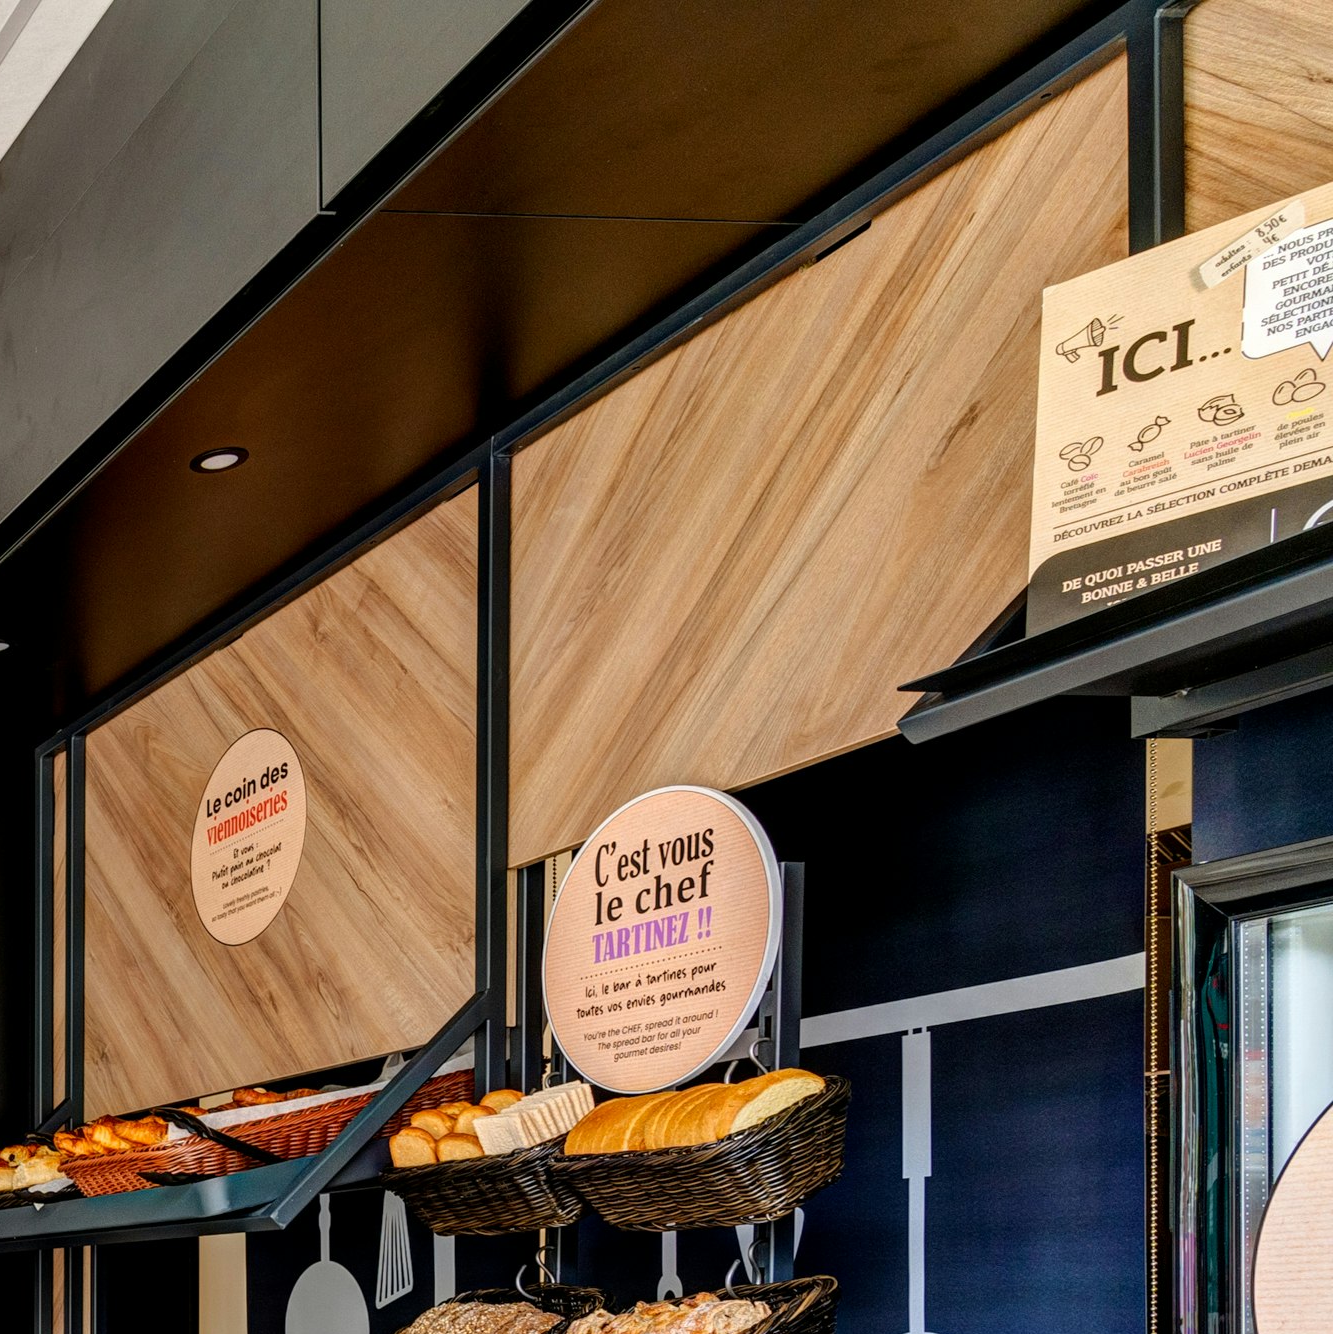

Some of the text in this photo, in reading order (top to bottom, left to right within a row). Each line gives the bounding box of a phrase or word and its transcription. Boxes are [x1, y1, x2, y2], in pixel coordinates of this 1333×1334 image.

[1277, 234, 1314, 254] NOUS
[1262, 255, 1286, 271] DES
[1272, 261, 1333, 290] PETIT DÉ
[1267, 321, 1293, 336] NOS
[1096, 318, 1232, 397] ICI...
[1274, 421, 1325, 441] élevées en
[1277, 424, 1288, 432] de
[1291, 412, 1324, 430] poules
[1183, 430, 1261, 460] Lucien Georgelin
[1190, 438, 1209, 450] Pâte
[1221, 424, 1256, 440] tartiner
[1279, 430, 1321, 450] plein air
[1129, 451, 1165, 468] Caramel
[1191, 442, 1253, 466] sans huile de
[1207, 456, 1236, 472] palme
[1061, 478, 1079, 489] Café
[1114, 472, 1177, 497] de beurre salé
[1133, 472, 1150, 482] bon
[1153, 466, 1173, 479] goût
[1051, 486, 1107, 508] lentement en
[1063, 481, 1095, 497] torréfié
[1053, 514, 1125, 543] DÉCOUVREZ
[1127, 510, 1143, 522] LA
[1146, 488, 1216, 516] SÉLECTION
[1219, 467, 1290, 494] COMPLÈTE
[1059, 498, 1097, 514] Bretagne
[1062, 539, 1222, 592] DE QUOI PASSER UNE
[1081, 562, 1199, 604] BONNE & BELLE
[207, 762, 288, 818] Le coin des
[207, 786, 287, 846] viennoiseries
[230, 860, 243, 877] pain
[245, 858, 253, 866] au
[255, 842, 282, 862] chocolat
[595, 828, 714, 888] C'est vous
[221, 882, 229, 890] ou
[231, 864, 264, 886] chocolatine
[595, 860, 714, 926] le chef
[592, 911, 690, 964] TARTINEZ
[585, 962, 717, 998] Ici, le bar à tartines pour
[576, 980, 727, 1019] toutes vos envies gourmandes
[583, 1028, 607, 1042] You're
[607, 1025, 621, 1038] the
[621, 1022, 643, 1035] CHEF,
[645, 1018, 674, 1032] spread
[675, 1015, 681, 1026] it
[683, 1010, 713, 1024] around
[597, 1026, 701, 1051] The spread bar for all your
[613, 1042, 682, 1062] gourmet desires!
